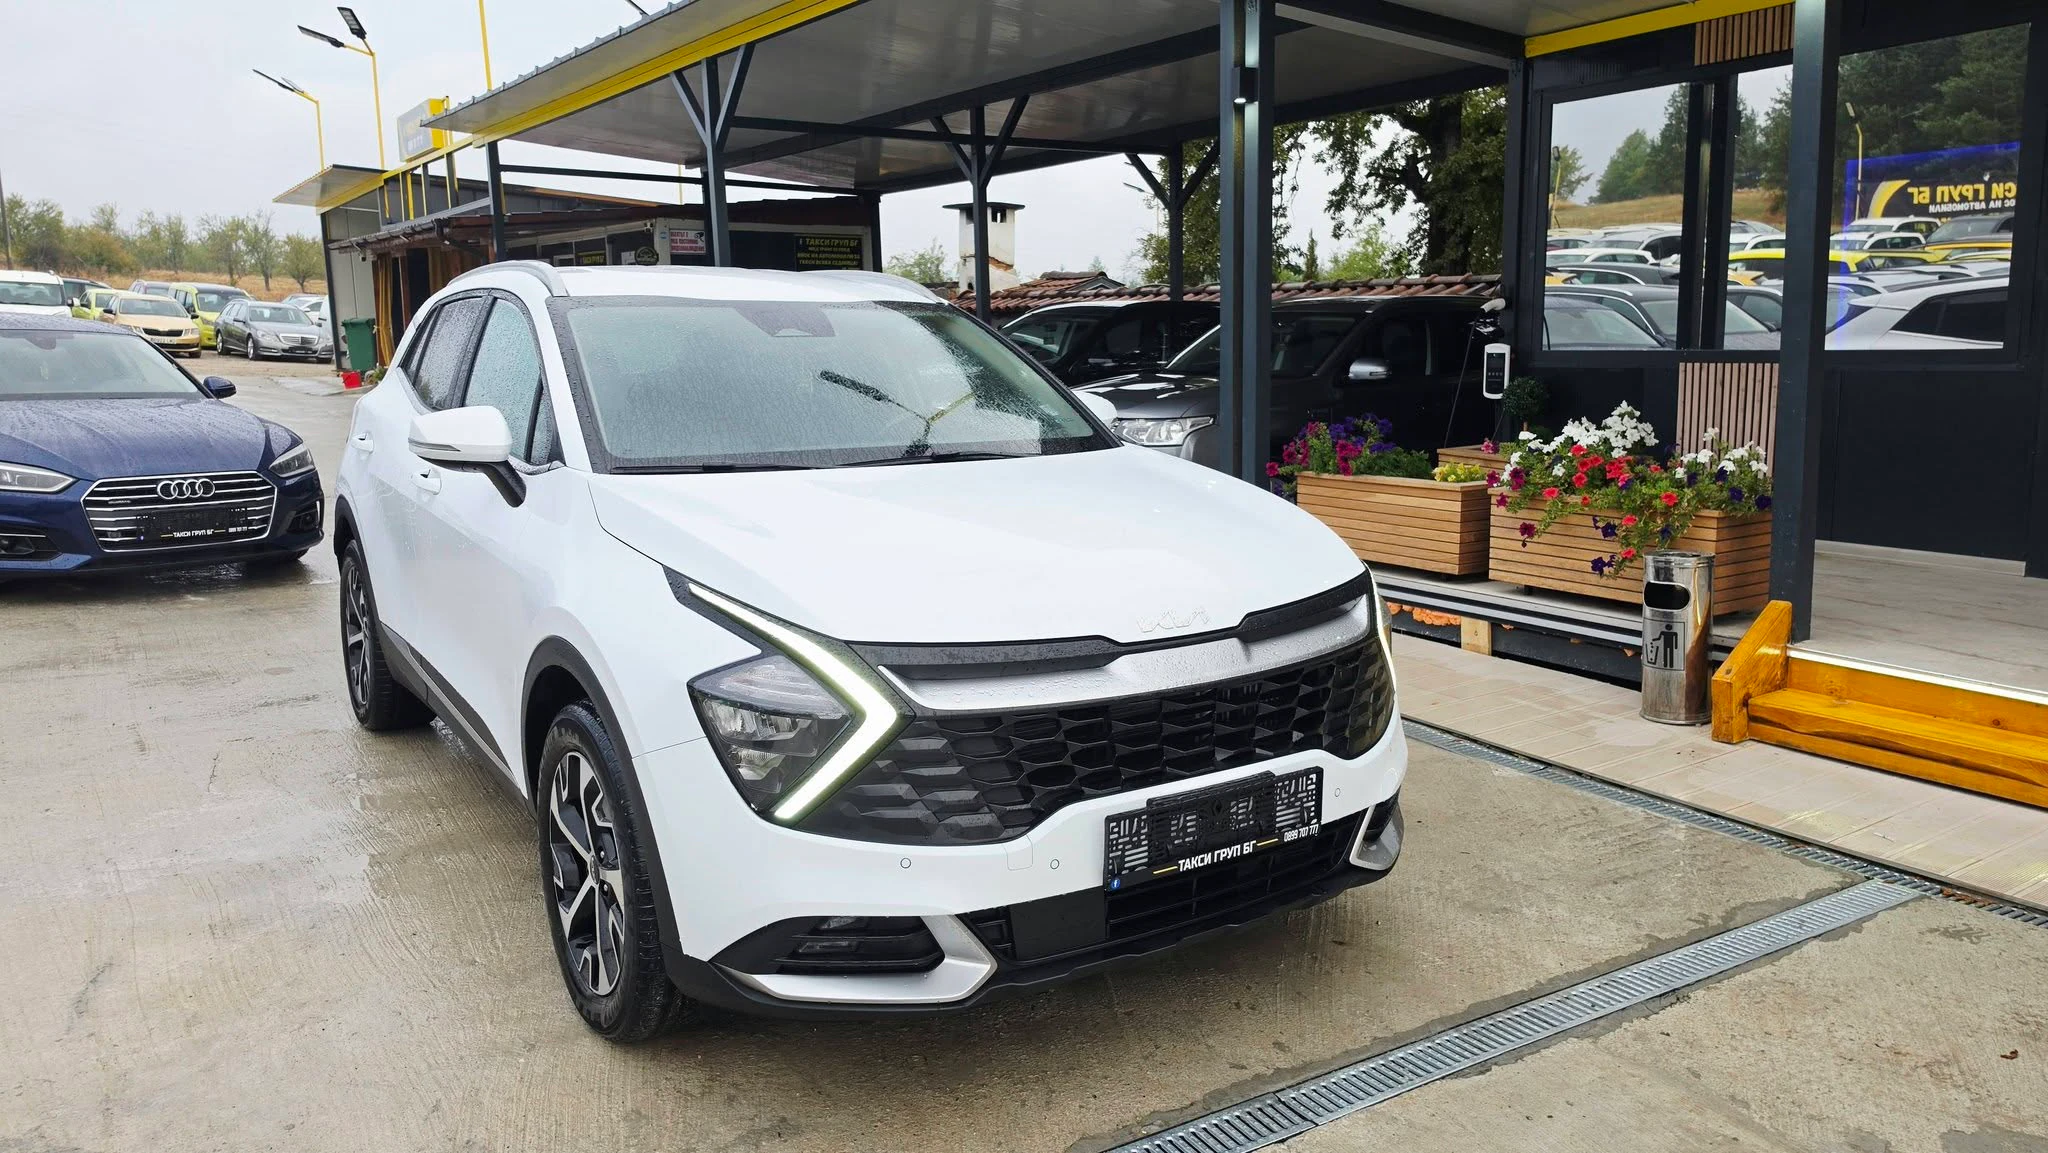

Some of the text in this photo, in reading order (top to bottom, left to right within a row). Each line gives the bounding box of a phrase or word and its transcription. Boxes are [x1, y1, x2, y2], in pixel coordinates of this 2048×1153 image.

[805, 238, 829, 246] ТАКСИ
[830, 239, 849, 247] ГРУП
[191, 529, 206, 537] ГРУП
[1178, 840, 1257, 872] ТАКСИ ГРУП БГ
